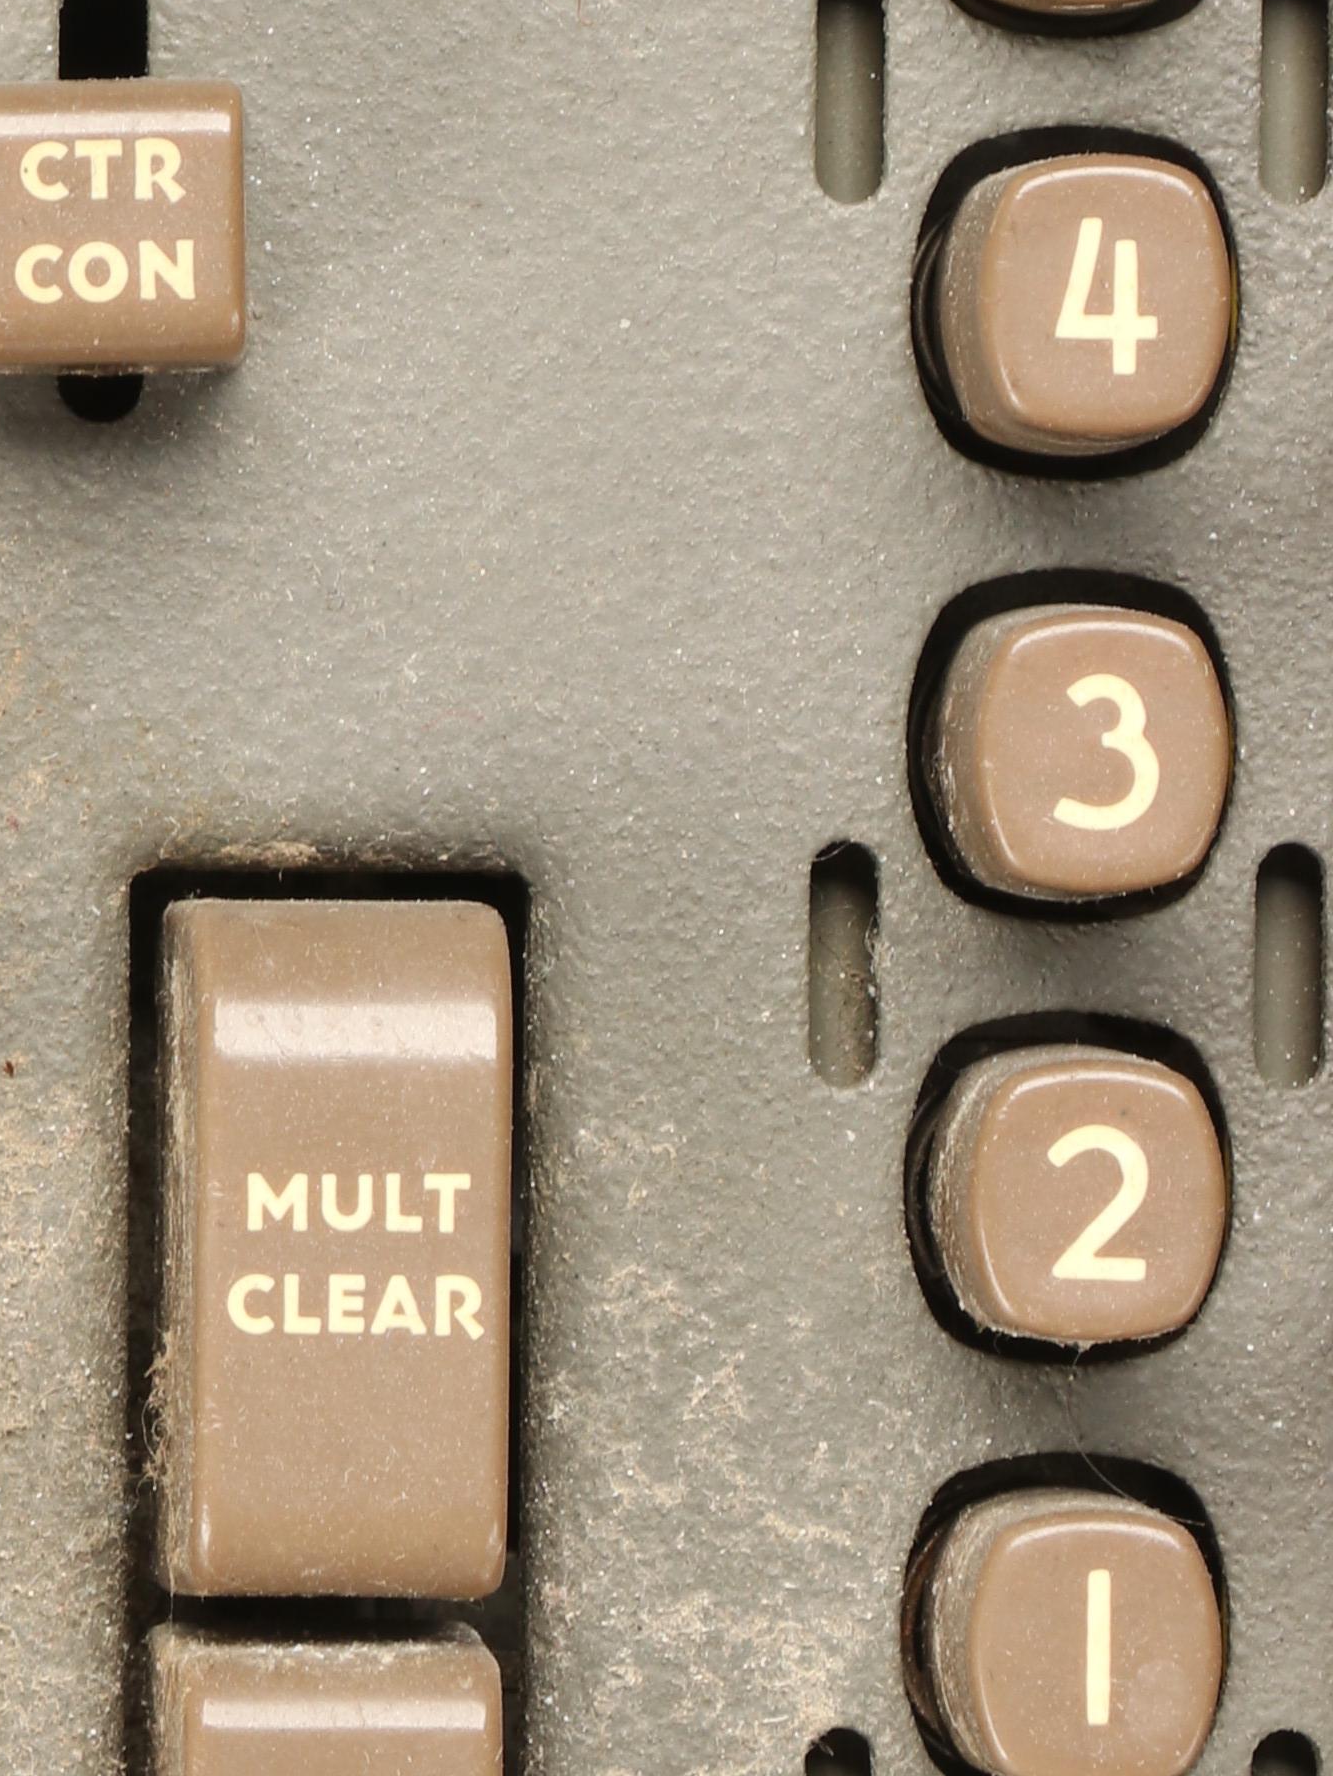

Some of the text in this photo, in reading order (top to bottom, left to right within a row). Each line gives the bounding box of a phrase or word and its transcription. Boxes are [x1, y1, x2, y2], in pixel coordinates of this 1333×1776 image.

[19, 138, 187, 204] CTR
[15, 240, 195, 303] CON
[1055, 218, 1157, 375] 4
[1053, 674, 1159, 830] 3
[248, 1173, 470, 1233] MULT
[1048, 1125, 1148, 1281] 2
[227, 1274, 484, 1339] CLEAR
[1086, 1570, 1110, 1725] 1
